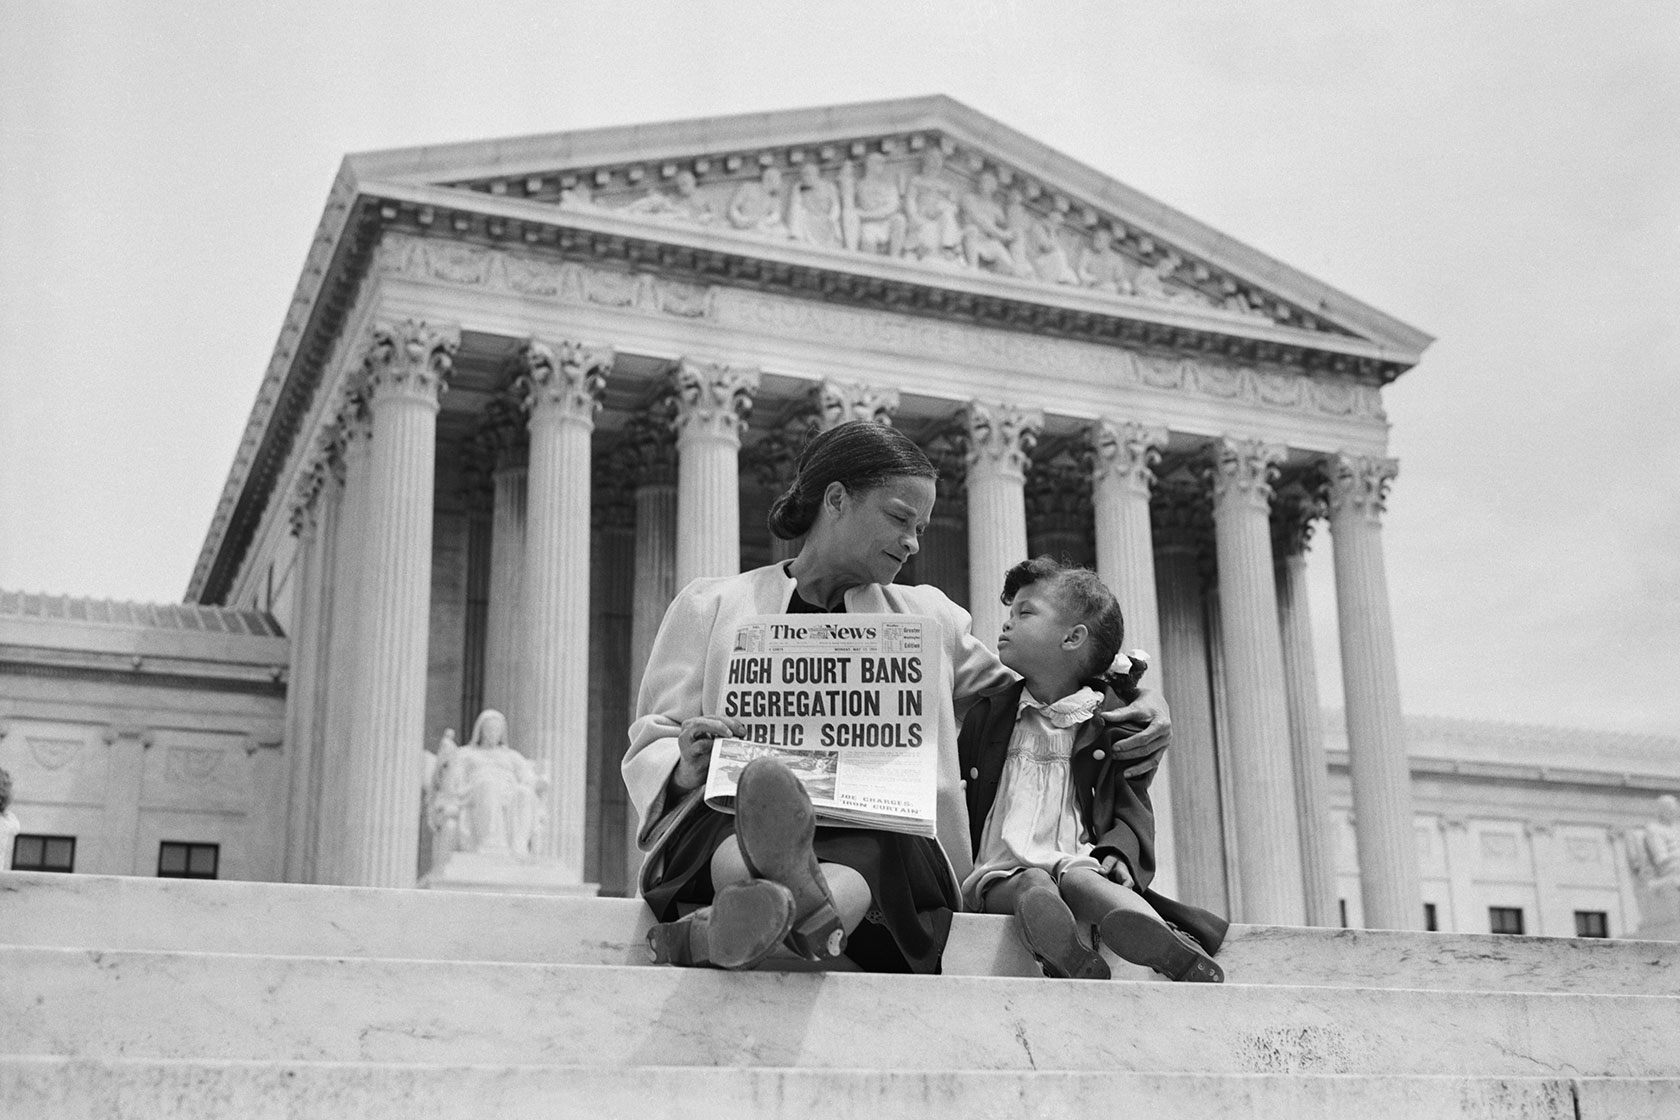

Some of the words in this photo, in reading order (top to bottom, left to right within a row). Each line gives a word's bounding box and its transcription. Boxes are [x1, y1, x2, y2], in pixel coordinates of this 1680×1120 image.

[770, 624, 808, 640] The
[824, 624, 877, 640] News
[728, 657, 772, 684] HIGH
[782, 657, 851, 684] COURT
[861, 657, 922, 684] BANS
[725, 690, 880, 717] SEGREGATION
[898, 690, 922, 716] IN
[742, 723, 804, 746] BLIC
[820, 722, 922, 747] SCHOOLS
[841, 793, 857, 801] JOE
